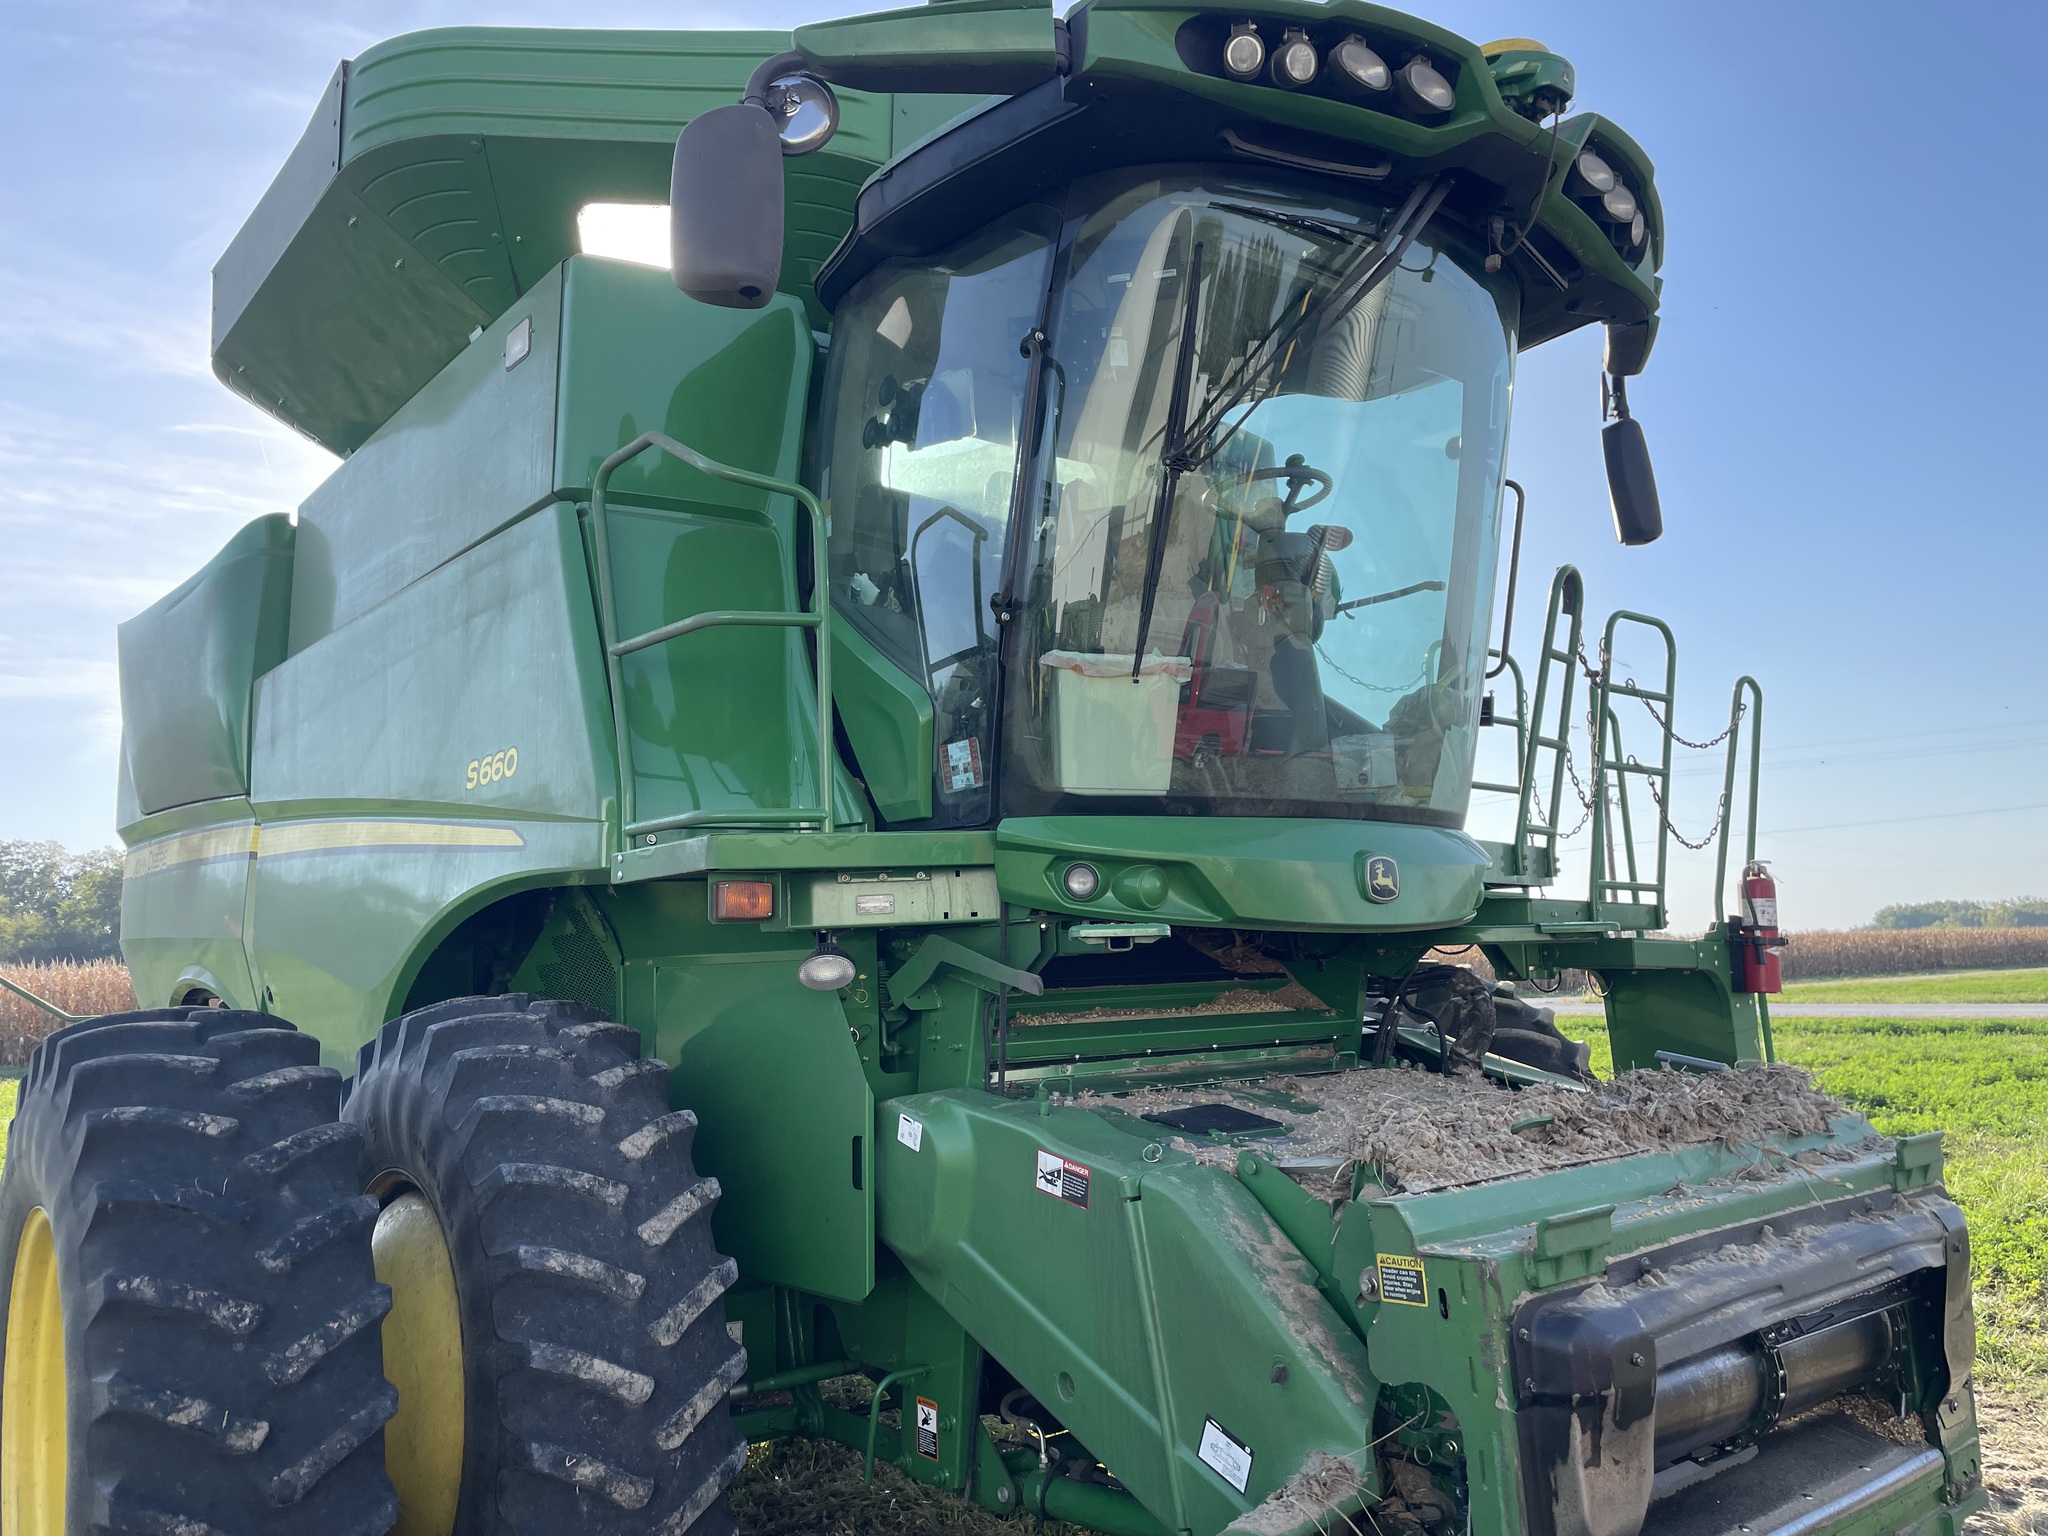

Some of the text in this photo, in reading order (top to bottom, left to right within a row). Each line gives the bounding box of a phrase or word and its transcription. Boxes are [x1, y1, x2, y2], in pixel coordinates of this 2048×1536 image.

[466, 747, 518, 790] S660
[1068, 1163, 1089, 1176] DANGER
[1386, 1257, 1422, 1268] CAUTION
[1396, 1275, 1417, 1283] crushing
[1389, 1292, 1408, 1300] running.
[1406, 1288, 1421, 1296] engine
